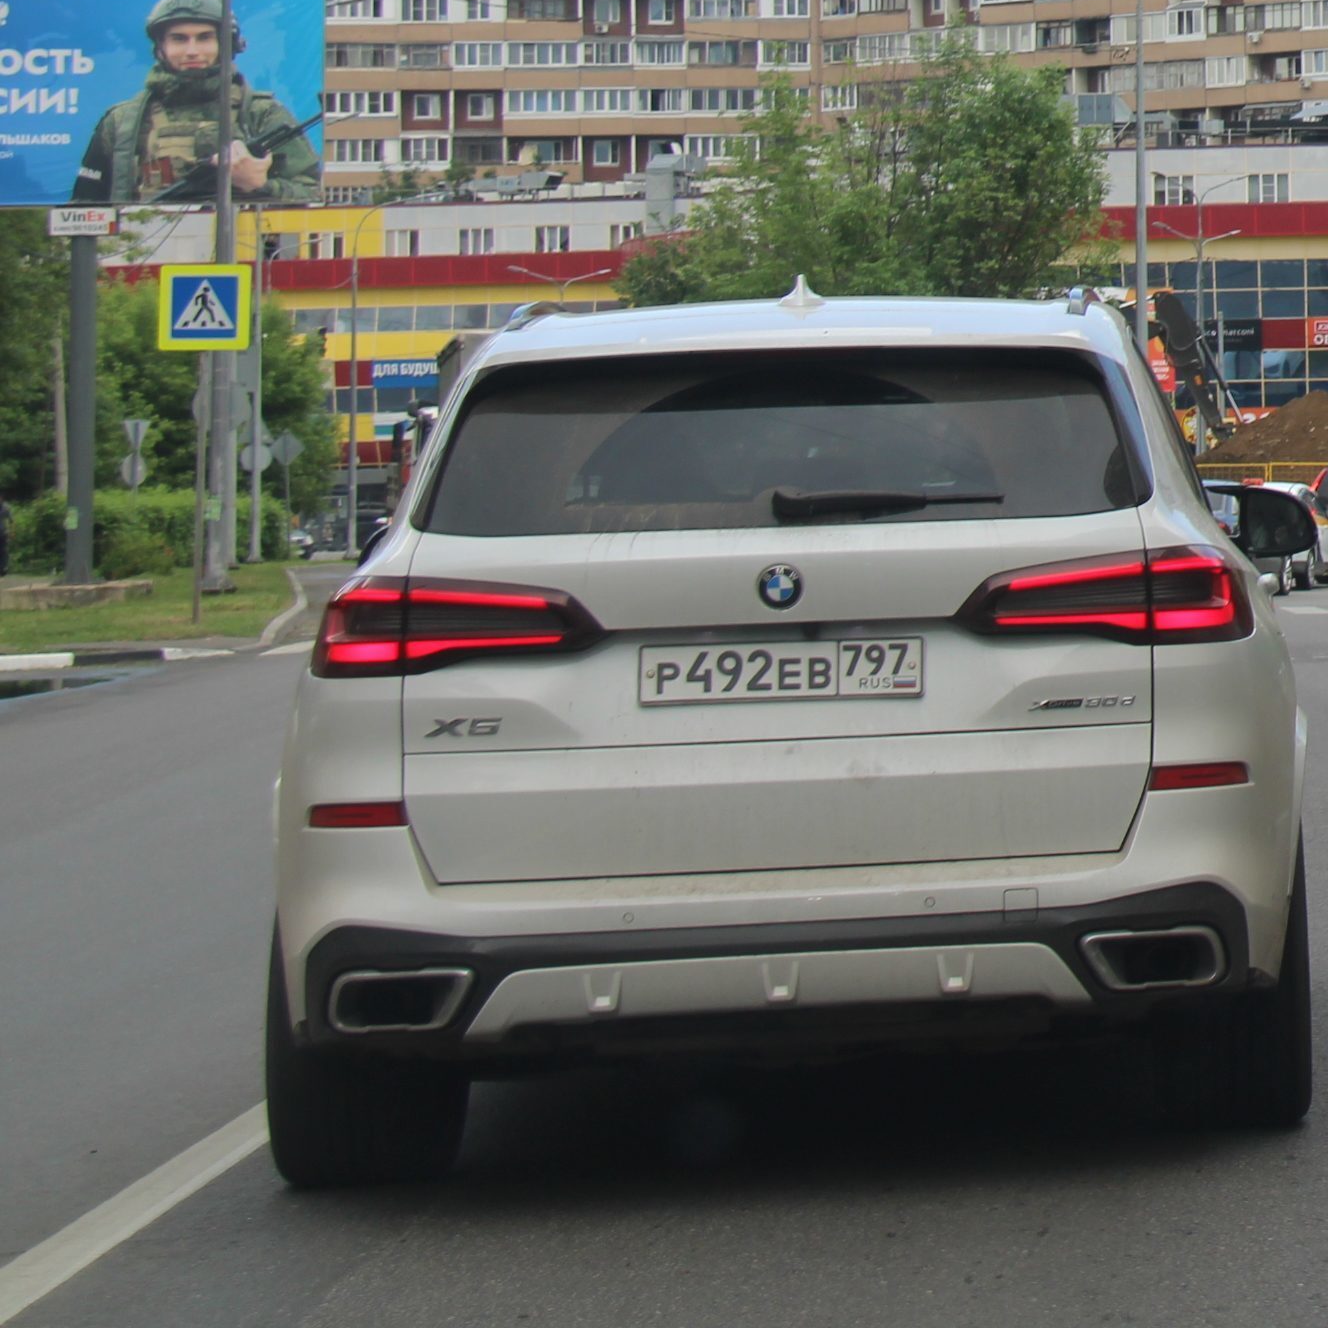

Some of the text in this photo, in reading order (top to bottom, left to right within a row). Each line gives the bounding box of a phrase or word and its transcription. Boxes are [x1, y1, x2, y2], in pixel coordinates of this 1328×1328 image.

[61, 211, 105, 222] VinEx
[373, 363, 398, 378] ДЛЯ
[656, 643, 909, 695] Р492ЕВ 797
[858, 677, 892, 689] RUS
